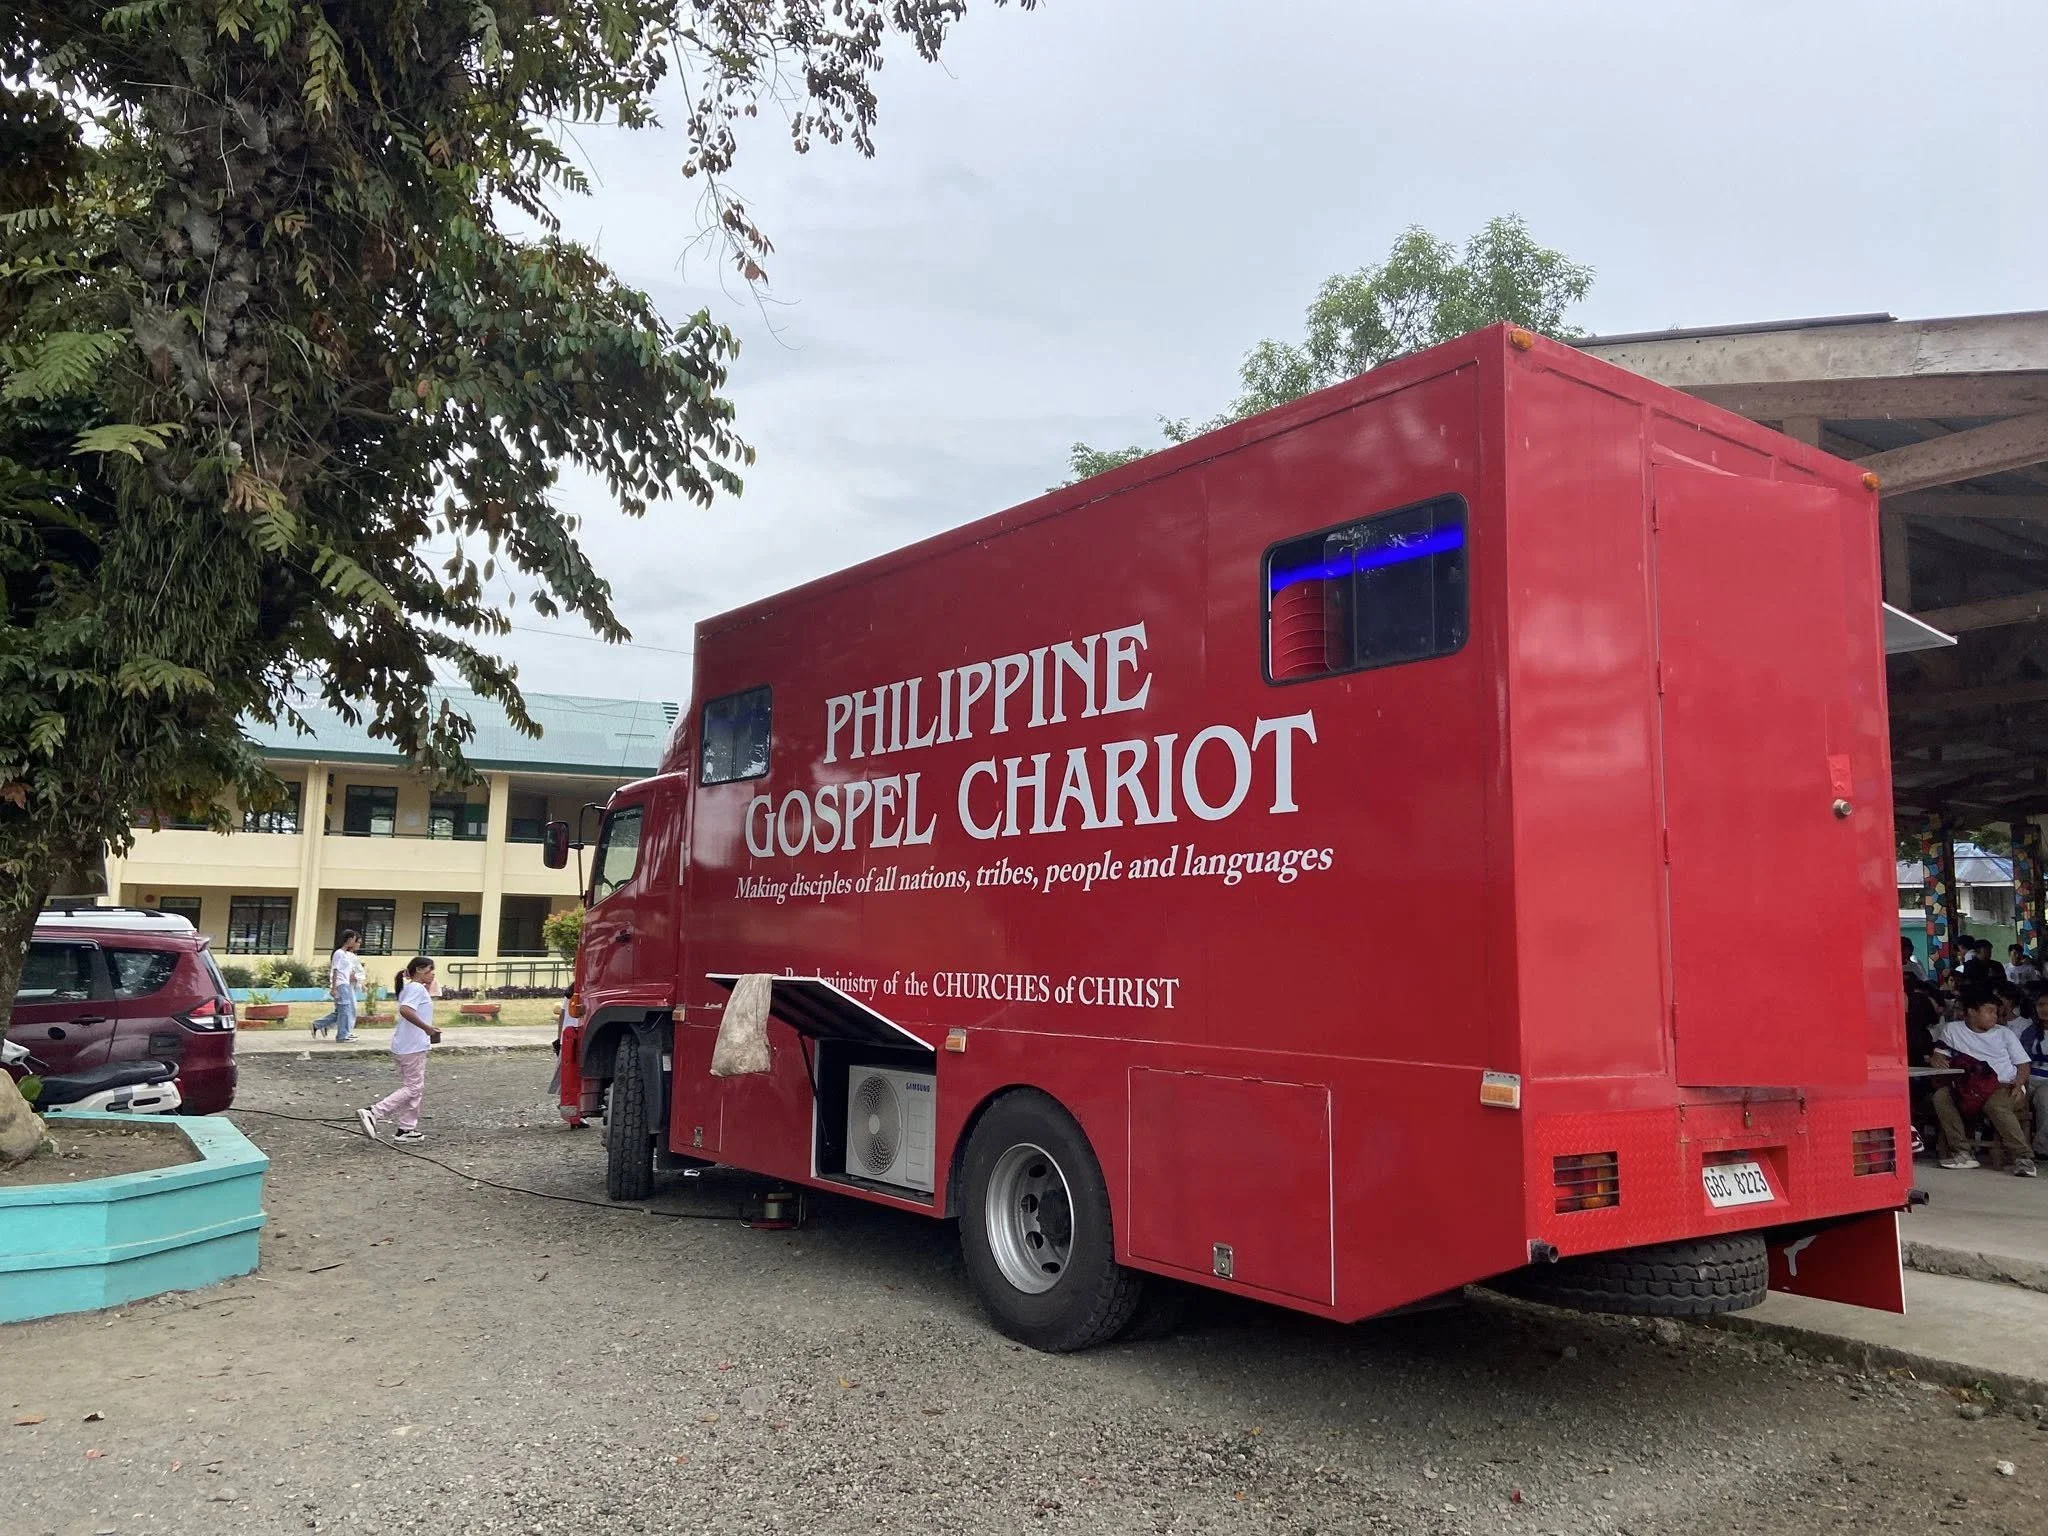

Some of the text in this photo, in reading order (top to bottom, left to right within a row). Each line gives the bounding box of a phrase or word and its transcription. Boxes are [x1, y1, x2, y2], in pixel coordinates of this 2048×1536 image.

[823, 620, 1153, 764] PHILIPPINE
[745, 709, 1318, 858] GOSPEL CHARIOT
[735, 843, 1334, 904] Making disciples of all nations, tribes, people and languages
[883, 970, 900, 995] of
[904, 971, 928, 997] the
[932, 971, 1050, 1003] CHURCHES
[1054, 976, 1075, 1004] of
[1078, 976, 1180, 1009] CHRIST
[905, 1081, 931, 1093] SAMSUNG
[1704, 1170, 1768, 1198] GBC 8223
